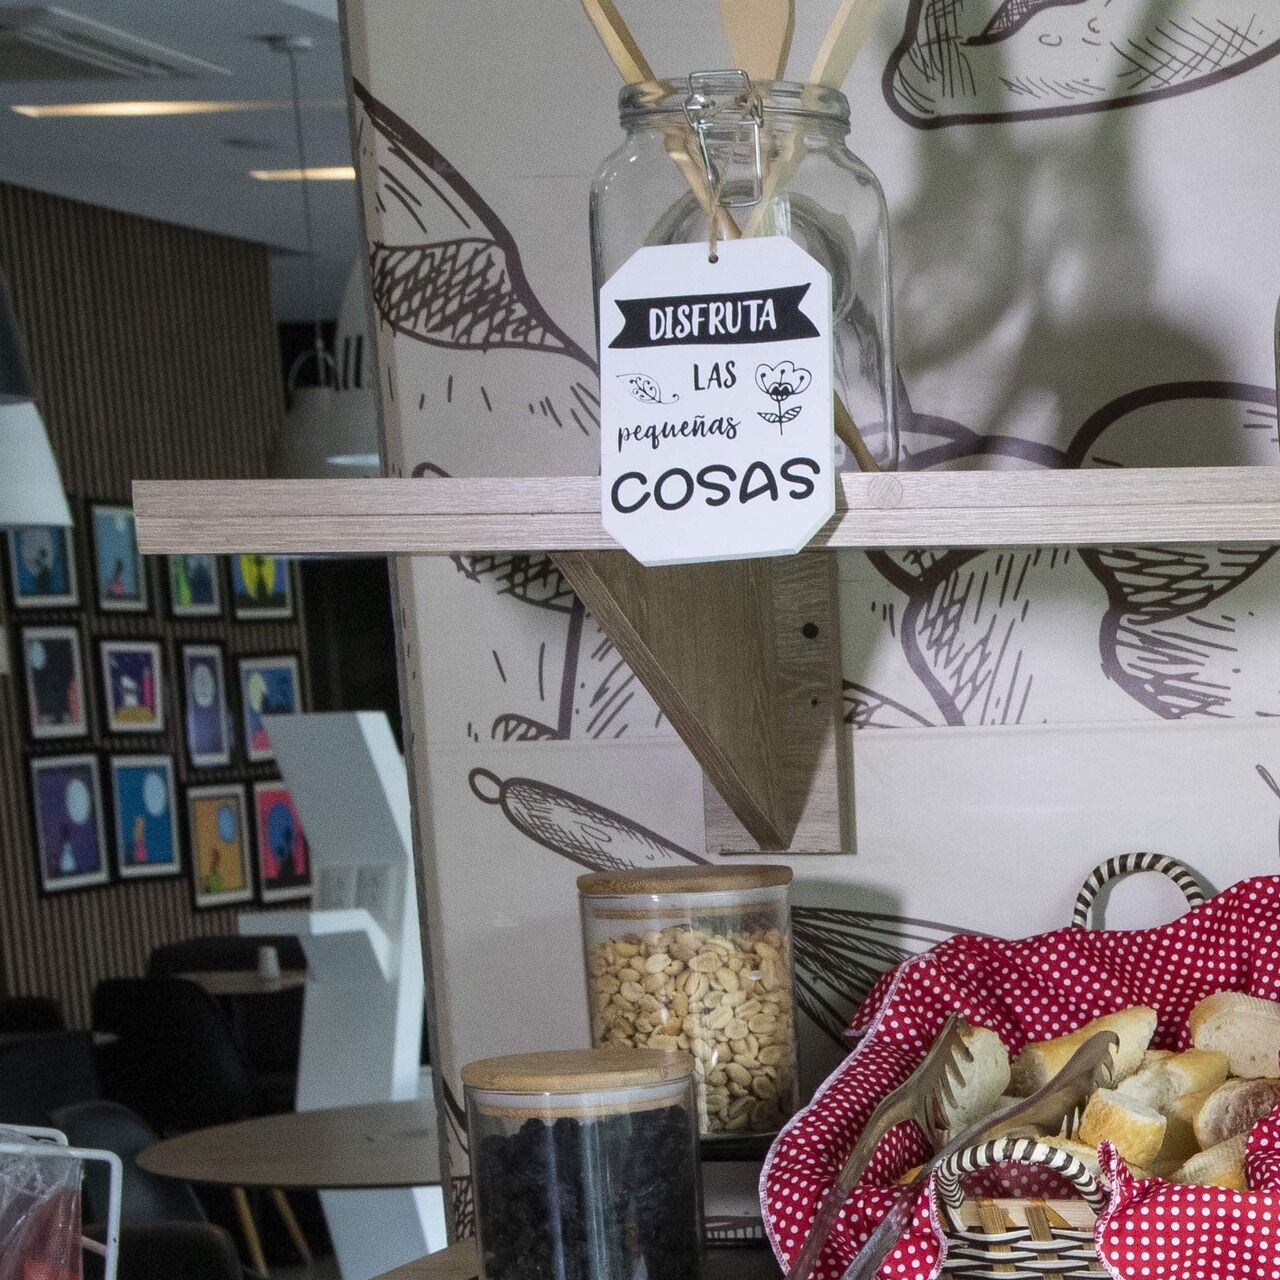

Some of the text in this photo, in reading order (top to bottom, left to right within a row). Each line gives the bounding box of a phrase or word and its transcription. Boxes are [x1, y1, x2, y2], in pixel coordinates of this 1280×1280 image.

[649, 298, 777, 340] DISFRUTA
[693, 360, 737, 391] LAS
[617, 415, 741, 453] pequeñas
[611, 457, 821, 513] COSAS
